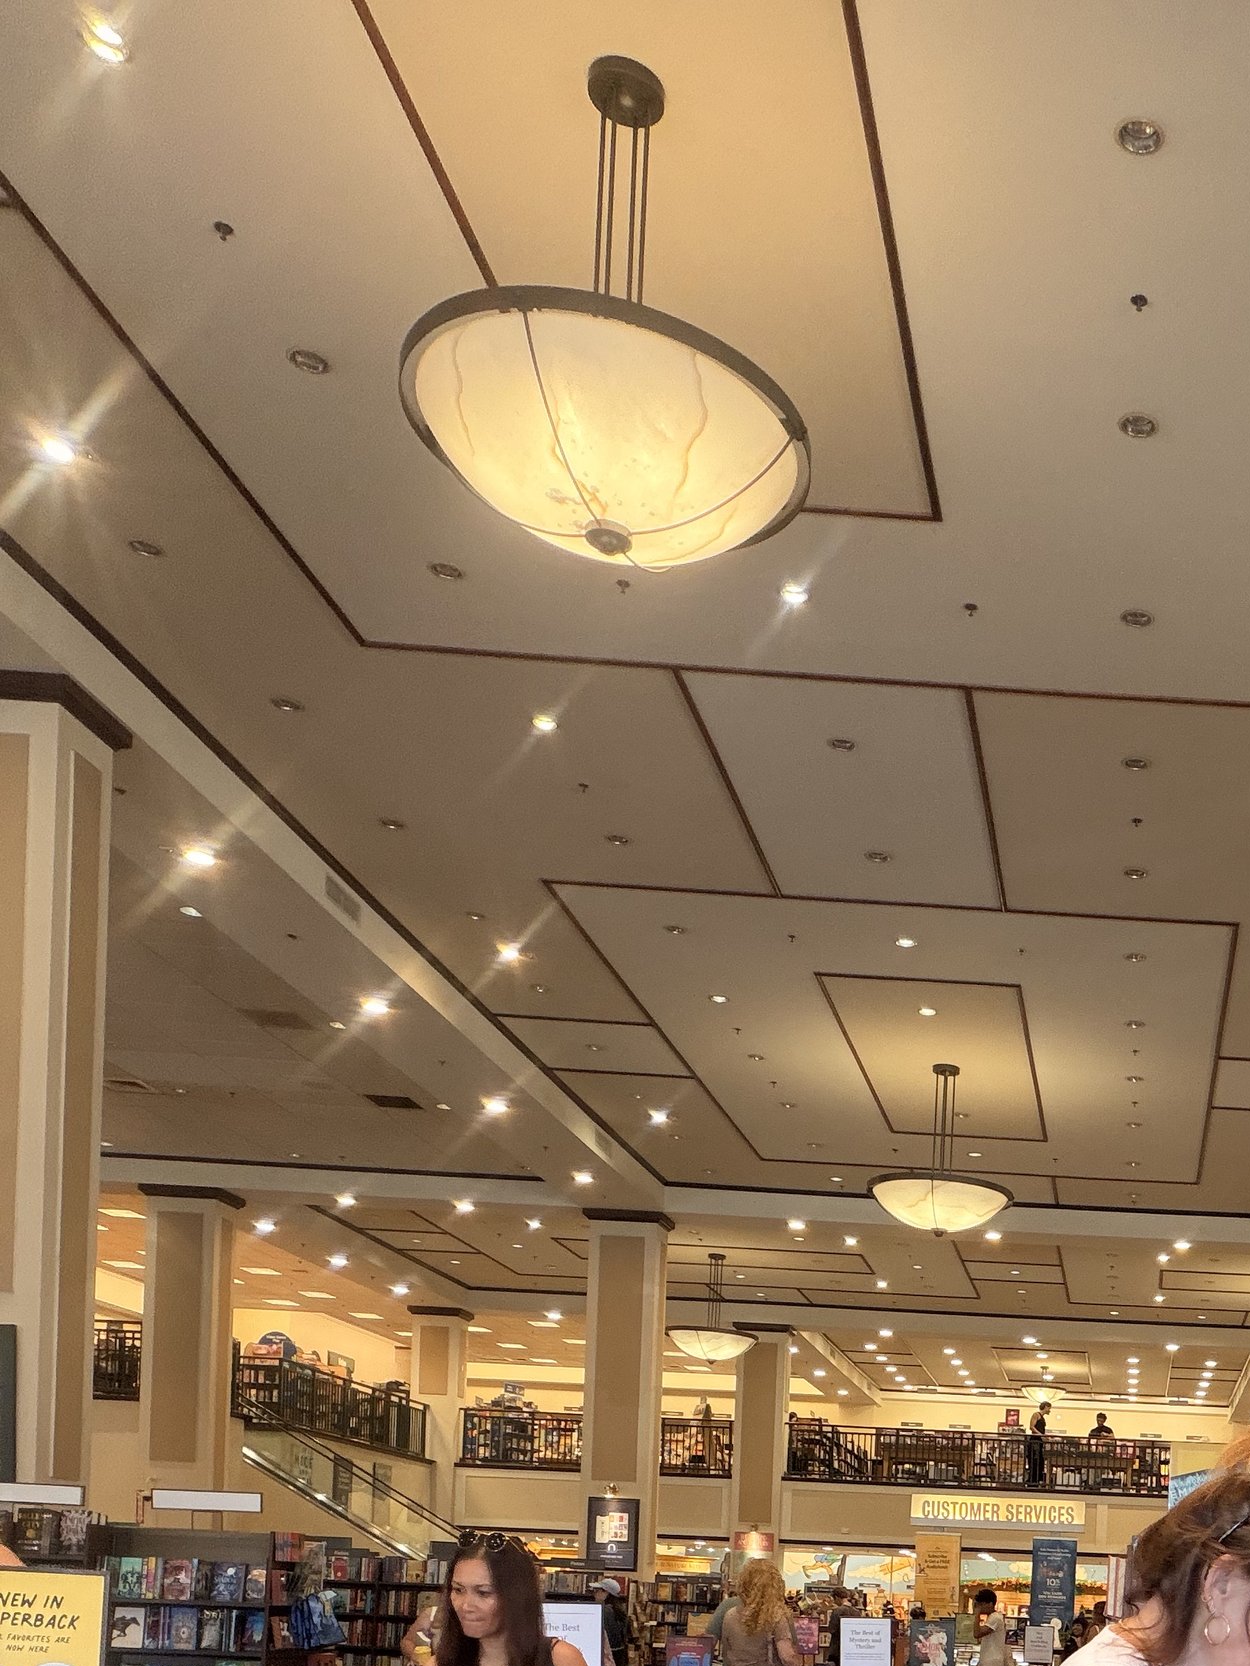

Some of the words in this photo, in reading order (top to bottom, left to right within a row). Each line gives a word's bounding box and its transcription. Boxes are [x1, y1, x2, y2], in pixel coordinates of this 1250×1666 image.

[922, 1499, 1000, 1521] CUSTOMER
[1005, 1504, 1075, 1524] SERVICES
[0, 1591, 38, 1609] NEW
[43, 1595, 65, 1609] IN
[561, 1623, 580, 1632] Best
[6, 1633, 51, 1643] FAVORITES
[54, 1636, 71, 1644] ARE
[5, 1644, 25, 1652] NOW
[28, 1645, 50, 1654] HERE
